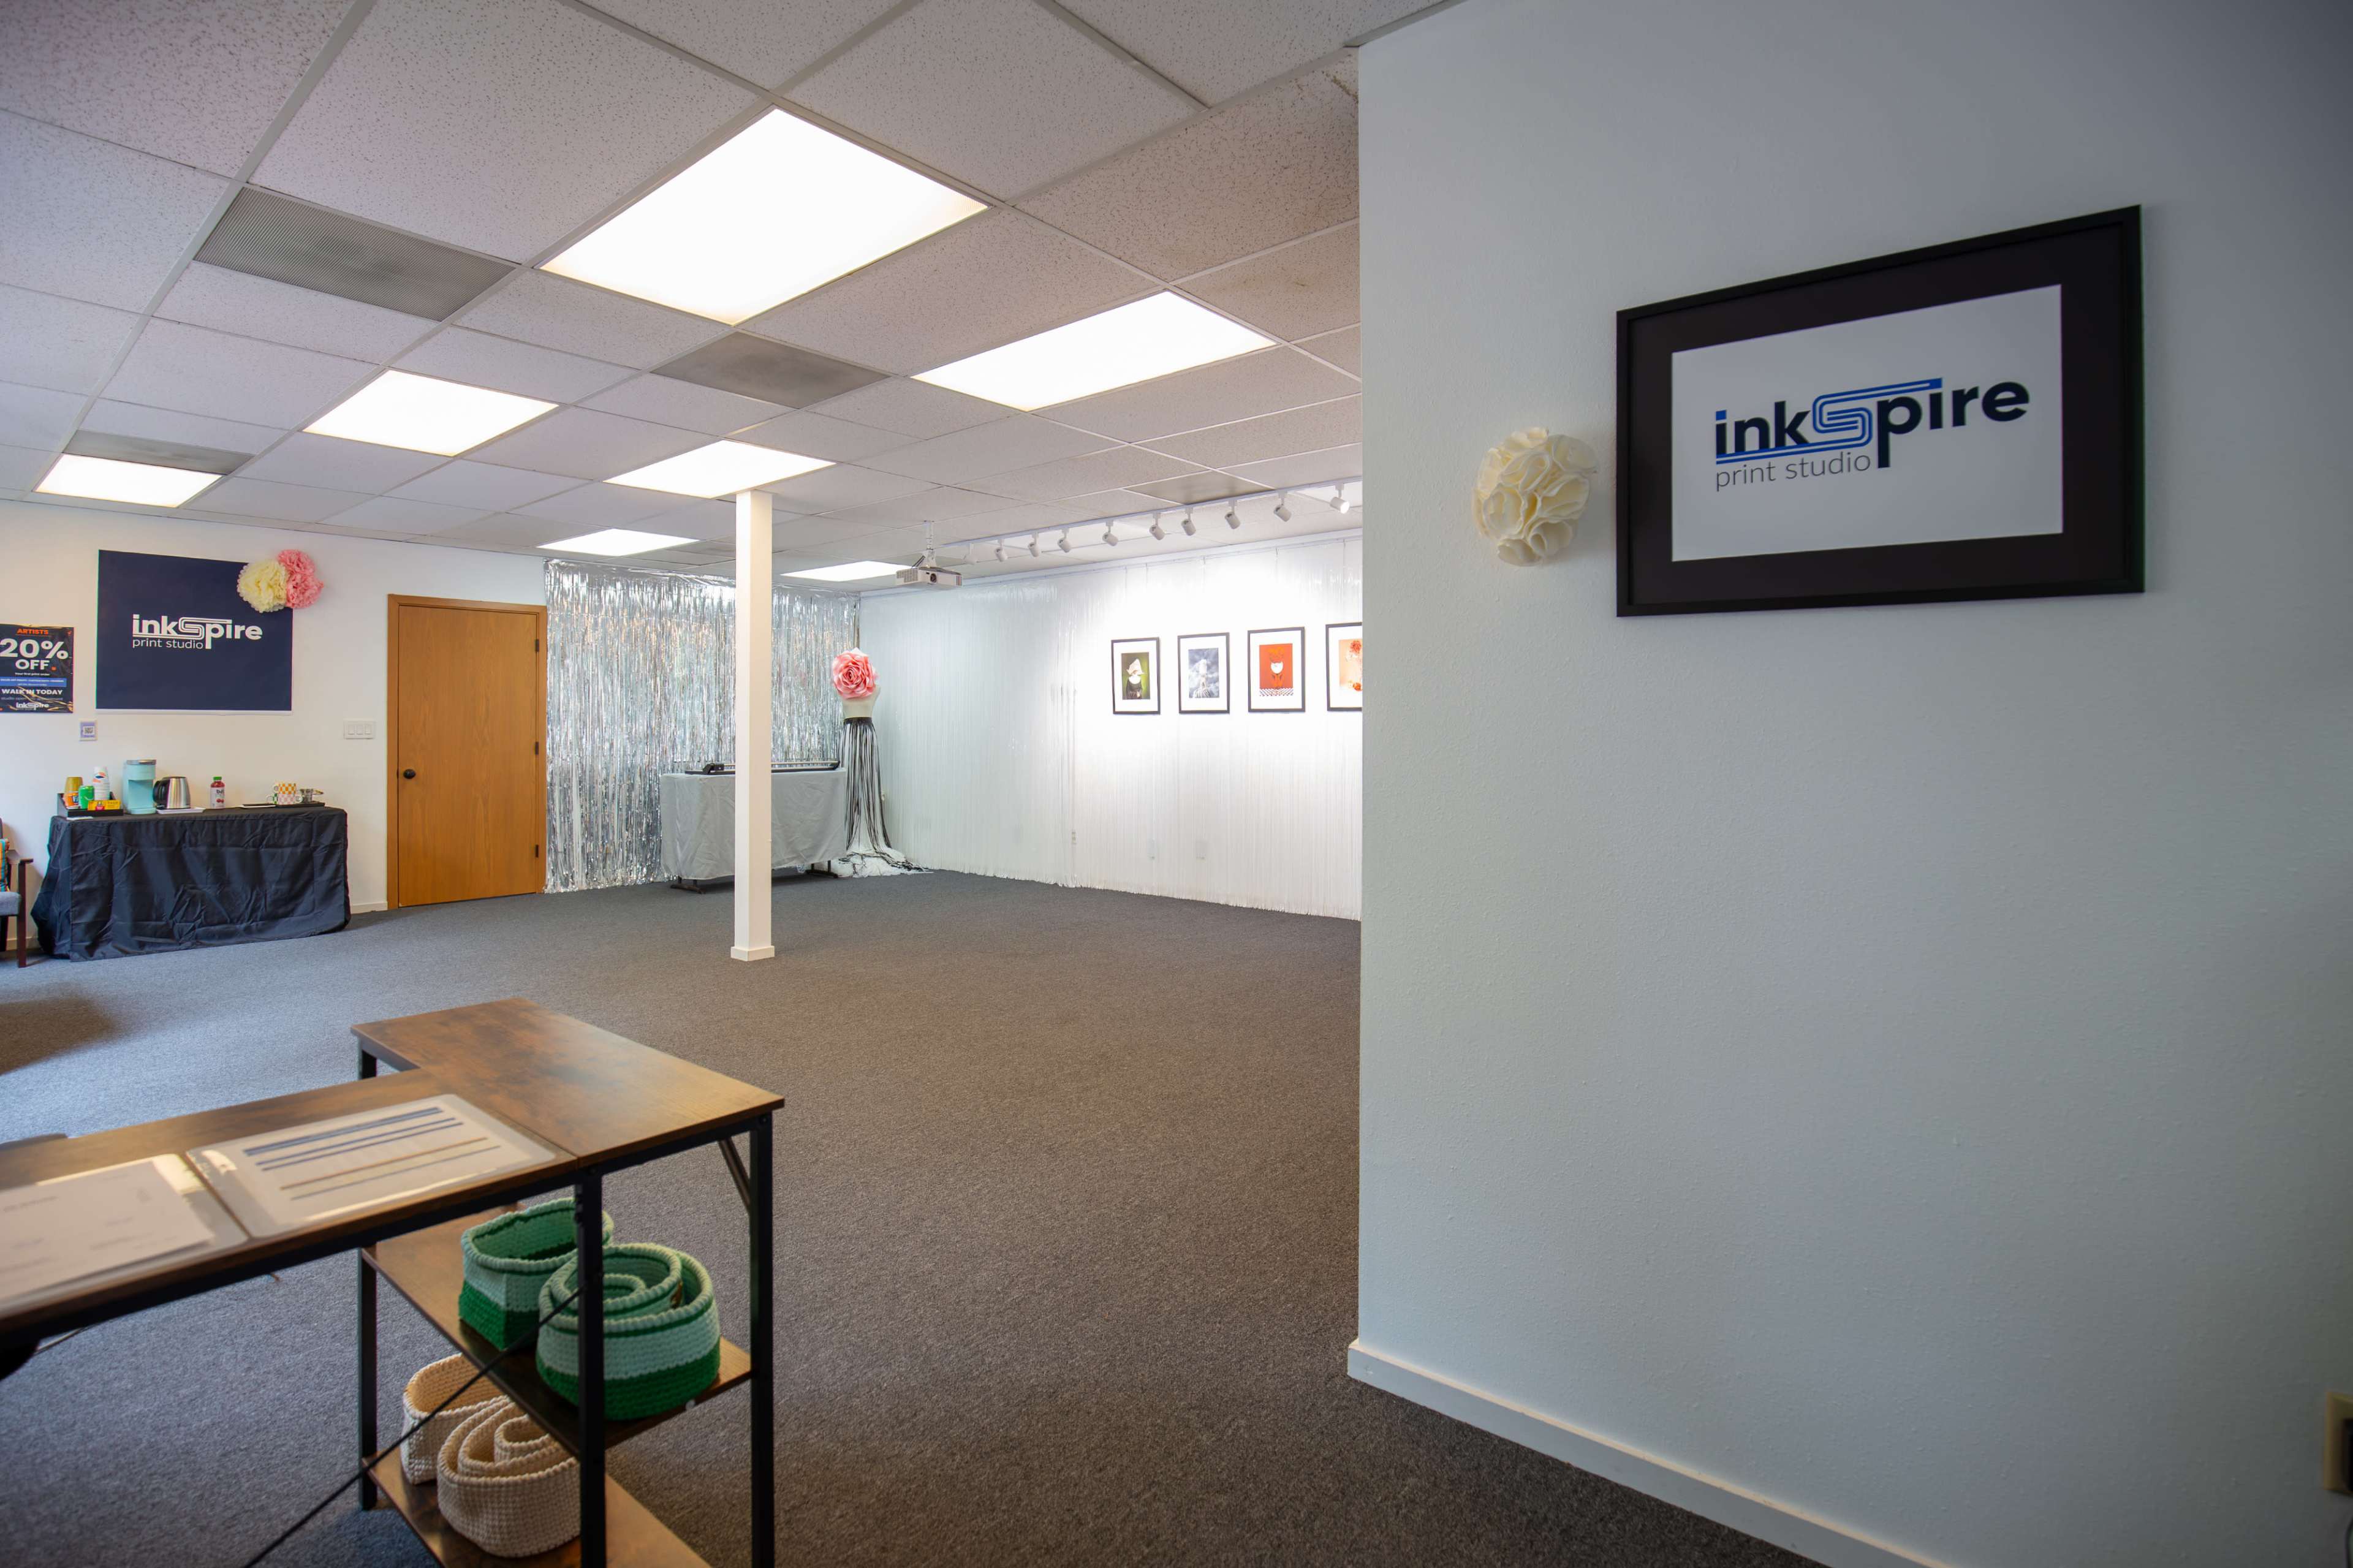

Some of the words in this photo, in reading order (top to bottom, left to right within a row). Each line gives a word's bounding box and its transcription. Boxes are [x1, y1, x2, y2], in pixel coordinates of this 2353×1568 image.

[1716, 461, 1776, 492] print
[1786, 451, 1871, 479] studio
[0, 638, 69, 660] 20%
[132, 638, 162, 648] print
[166, 639, 203, 650] studio
[15, 659, 50, 670] OFF
